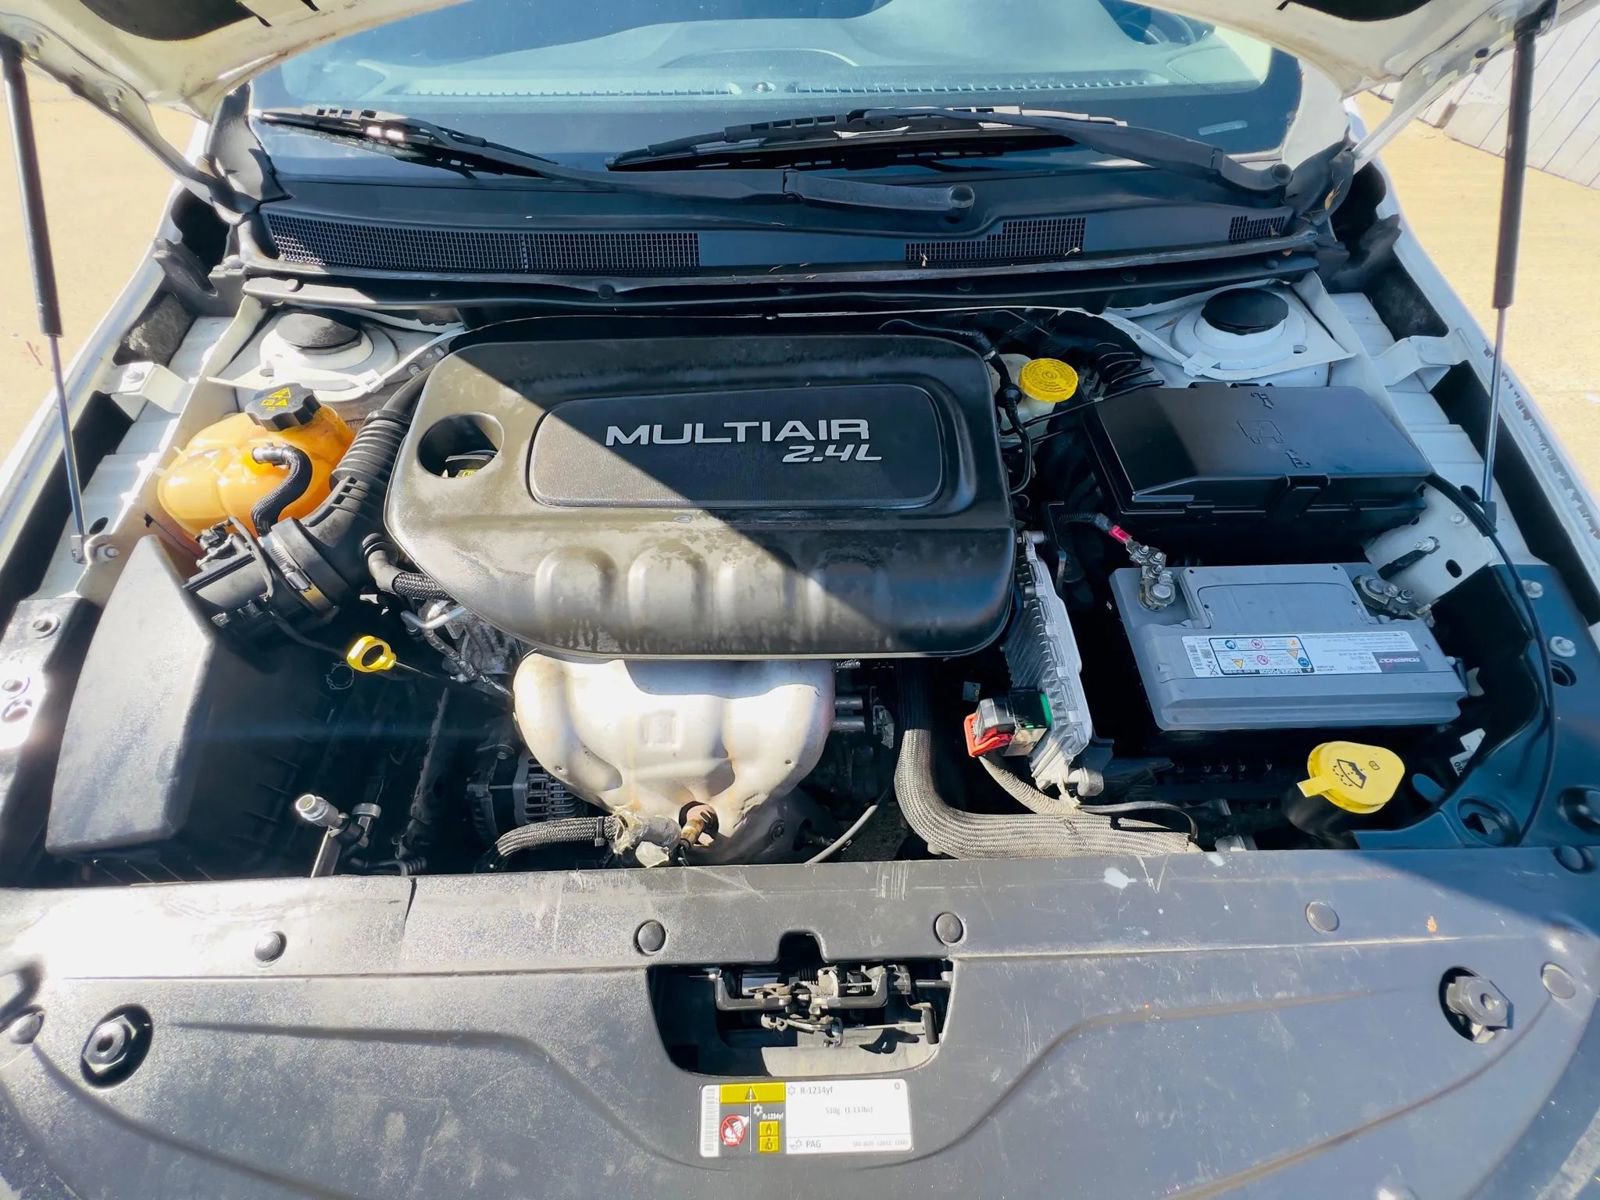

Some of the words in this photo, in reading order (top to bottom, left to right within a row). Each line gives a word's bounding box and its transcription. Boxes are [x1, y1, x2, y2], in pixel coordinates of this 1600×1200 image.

[605, 418, 870, 446] MULTIAIR
[782, 443, 882, 463] 2.4L
[806, 1140, 822, 1149] PAG
